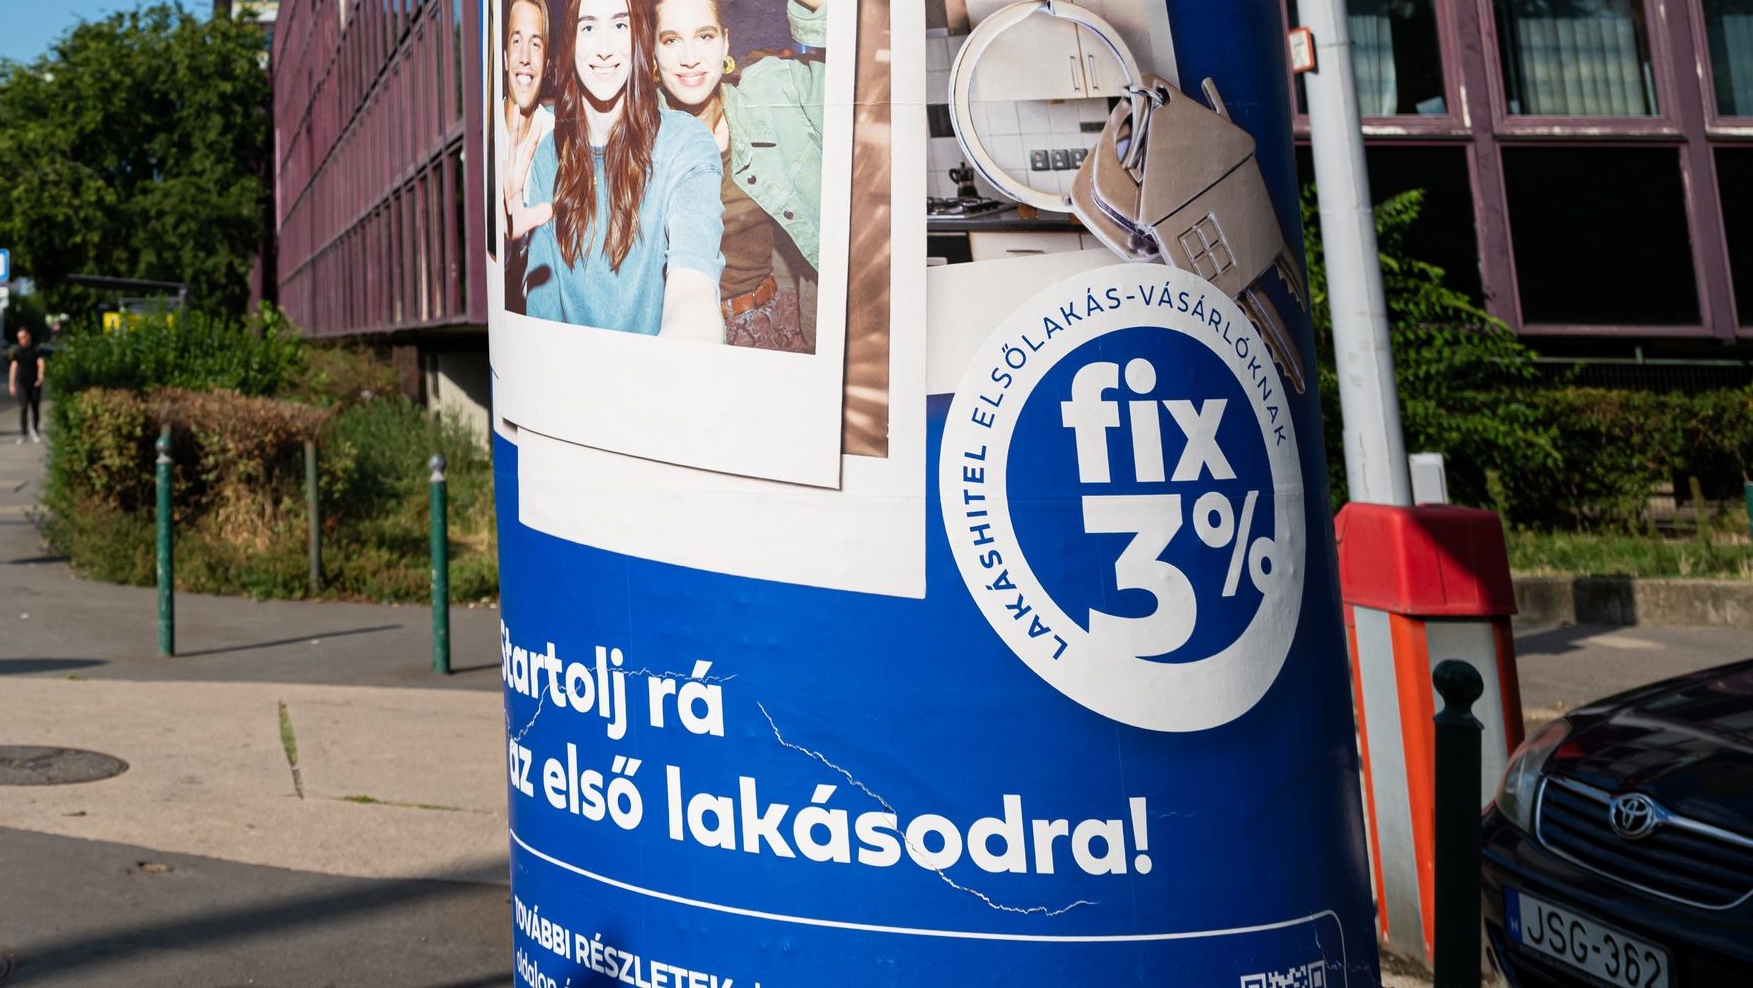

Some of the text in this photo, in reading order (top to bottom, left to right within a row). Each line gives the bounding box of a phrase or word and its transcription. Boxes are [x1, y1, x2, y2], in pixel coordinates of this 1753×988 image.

[963, 281, 1288, 661] LAKÁSHITEL ELSŐLAKÁS-VÁSÁRLÓKNAK
[1060, 357, 1237, 484] fix
[1081, 490, 1277, 658] 3%
[500, 618, 725, 740] Startolj rá
[509, 738, 1153, 875] az első lakásodra!
[514, 894, 571, 960] TOVÁBBI
[1527, 905, 1661, 988] JSG-362
